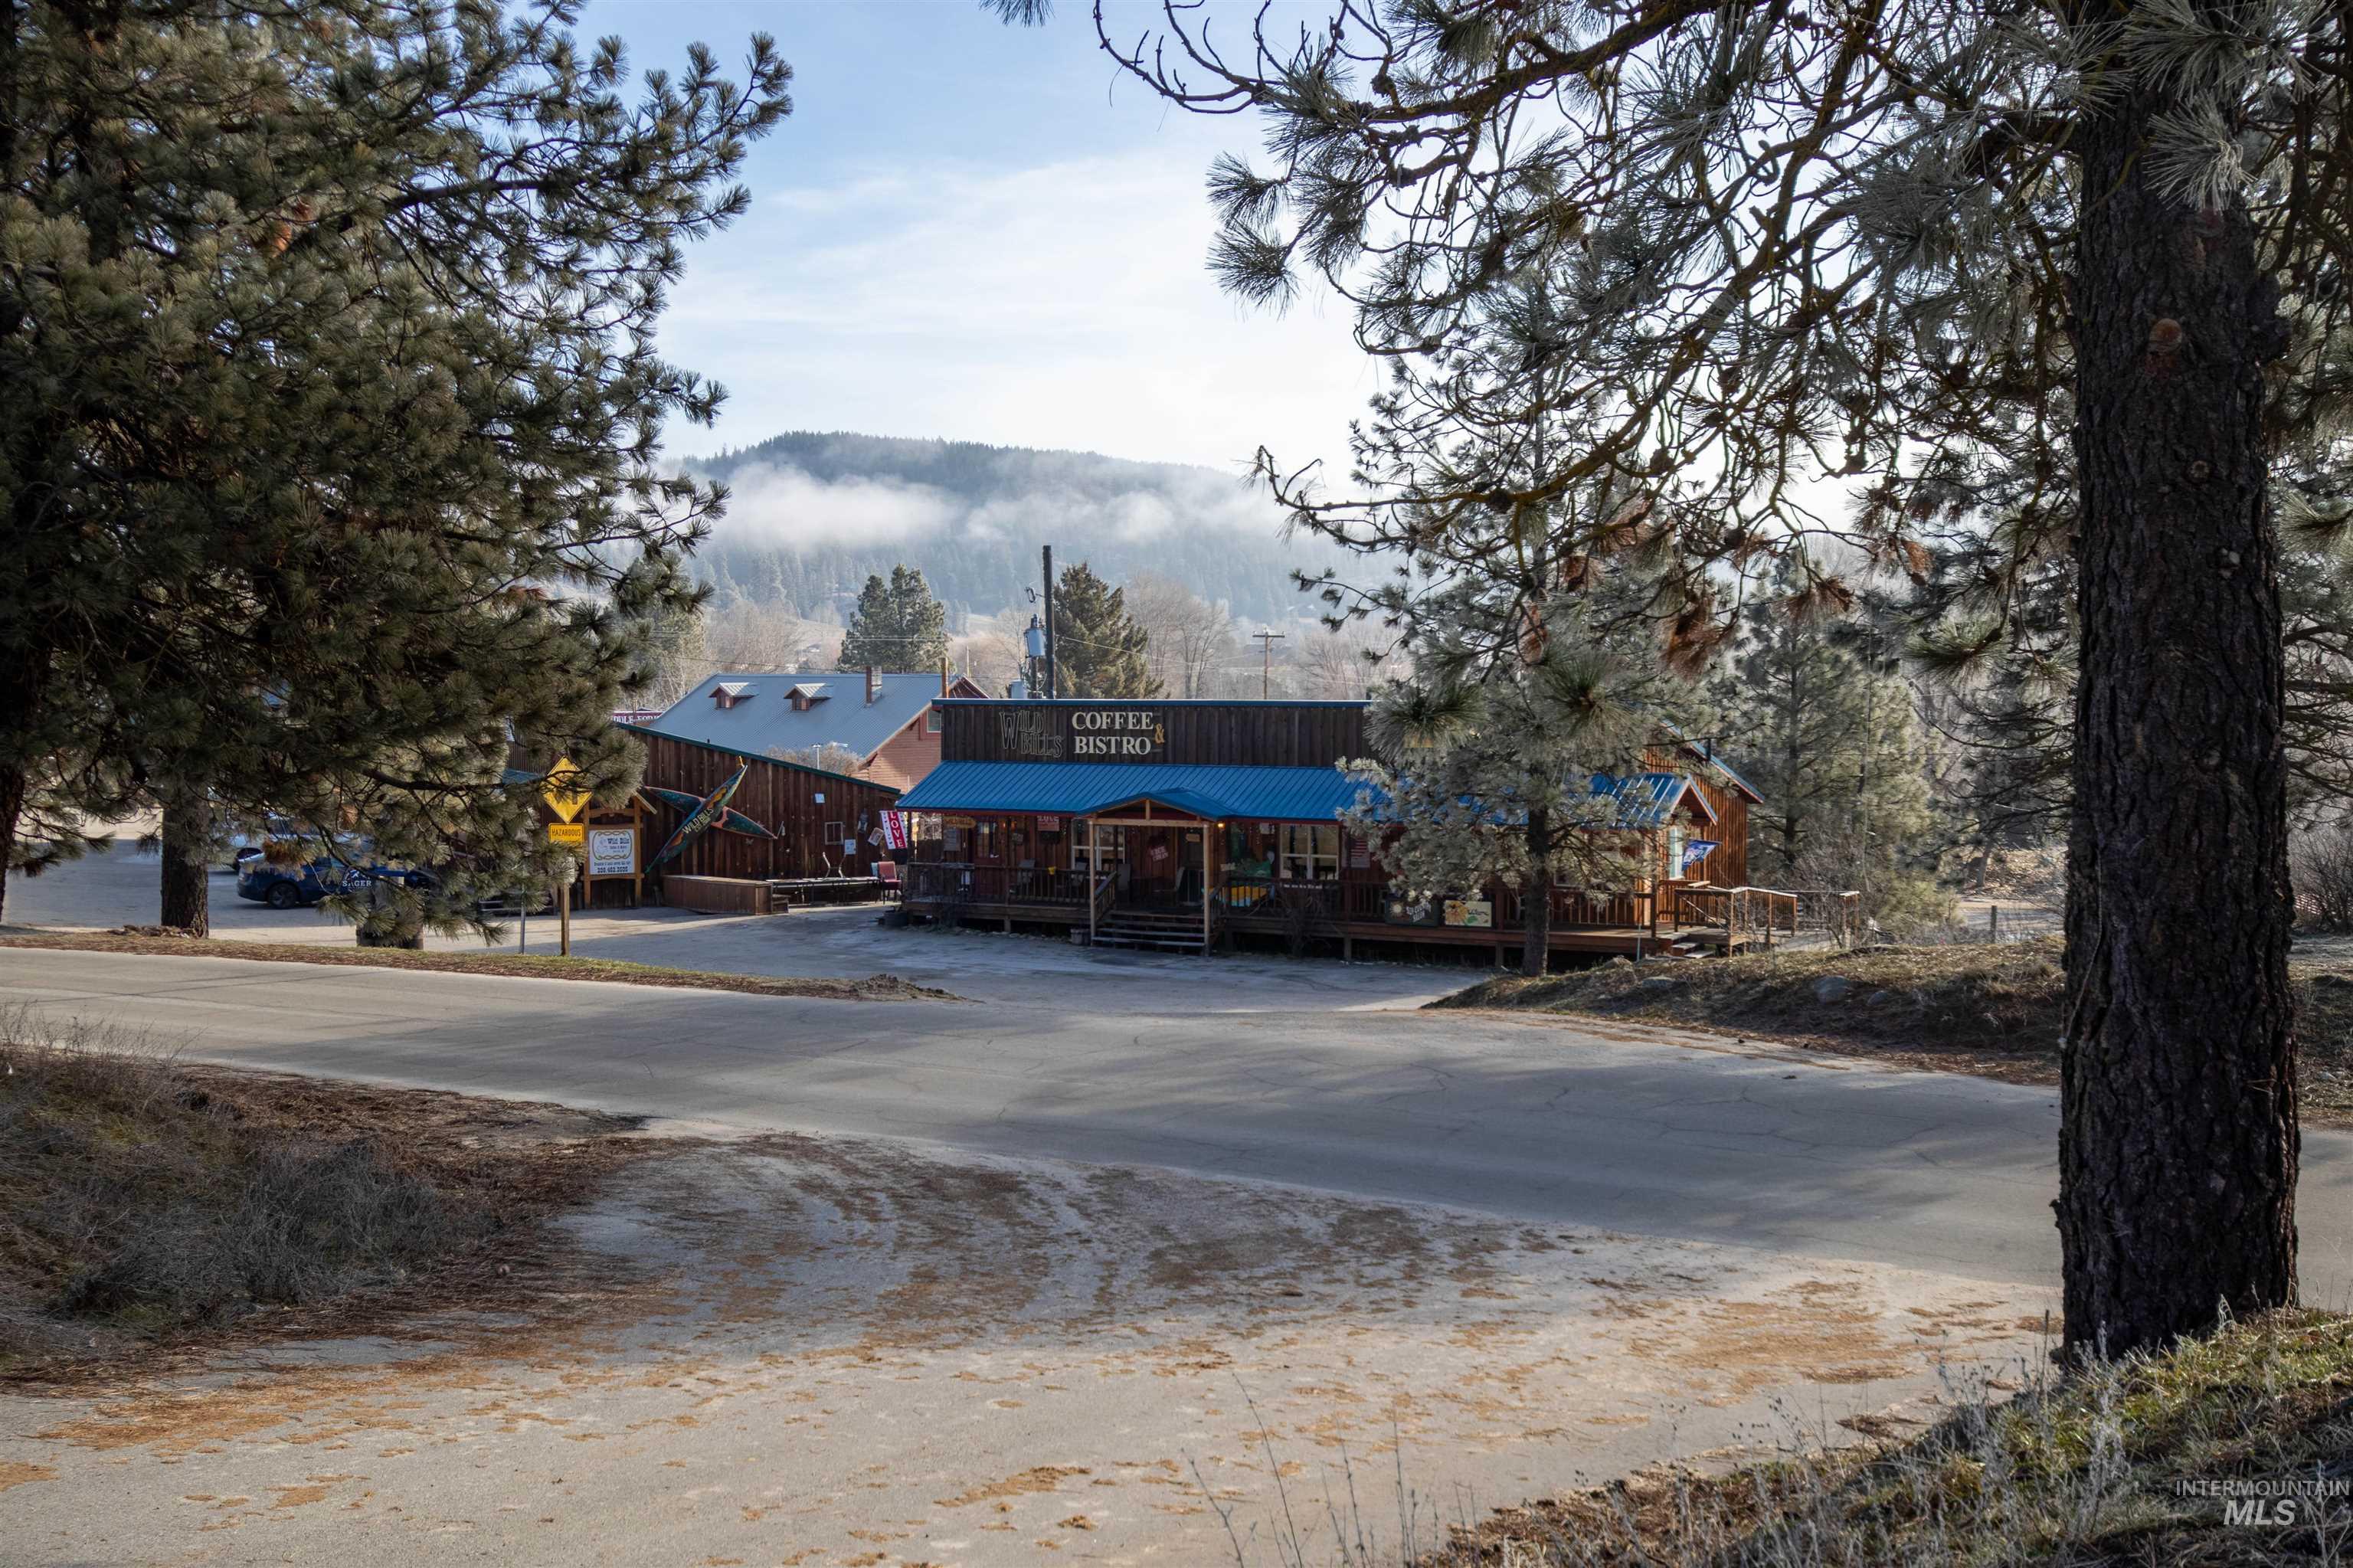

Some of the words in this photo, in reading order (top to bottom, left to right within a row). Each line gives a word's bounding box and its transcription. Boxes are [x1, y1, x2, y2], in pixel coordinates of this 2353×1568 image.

[1072, 712, 1154, 730] COFFEE
[1154, 723, 1165, 744] &
[1020, 733, 1063, 758] BILLS
[1074, 736, 1151, 755] BISTRO
[682, 817, 700, 834] WILD
[697, 808, 714, 822] BILLS
[889, 811, 904, 847] LOVE
